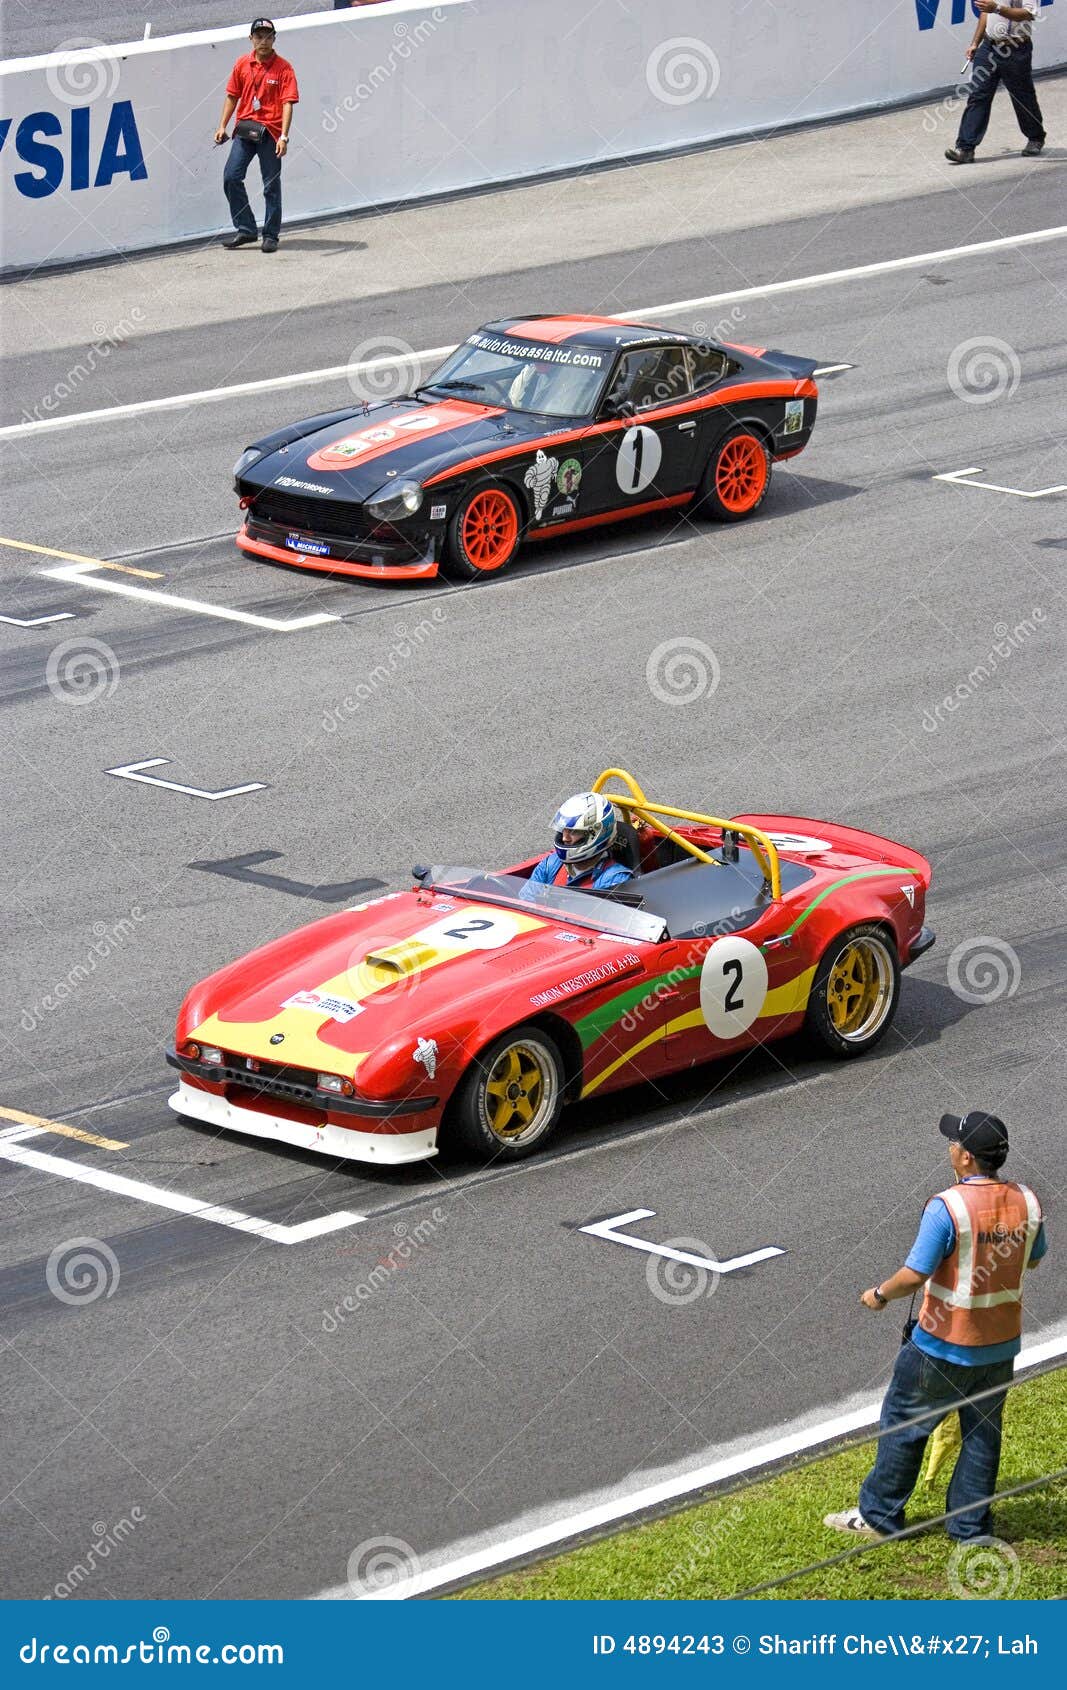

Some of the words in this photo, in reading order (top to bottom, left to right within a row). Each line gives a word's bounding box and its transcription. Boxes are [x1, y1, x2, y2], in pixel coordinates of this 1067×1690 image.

[0, 100, 148, 199] SIA
[632, 429, 644, 488] 1
[296, 542, 328, 554] MICHELIN
[443, 919, 495, 940] 2
[529, 985, 562, 1007] SIMON
[560, 962, 618, 994] WESTBROOK
[722, 958, 745, 1013] 2
